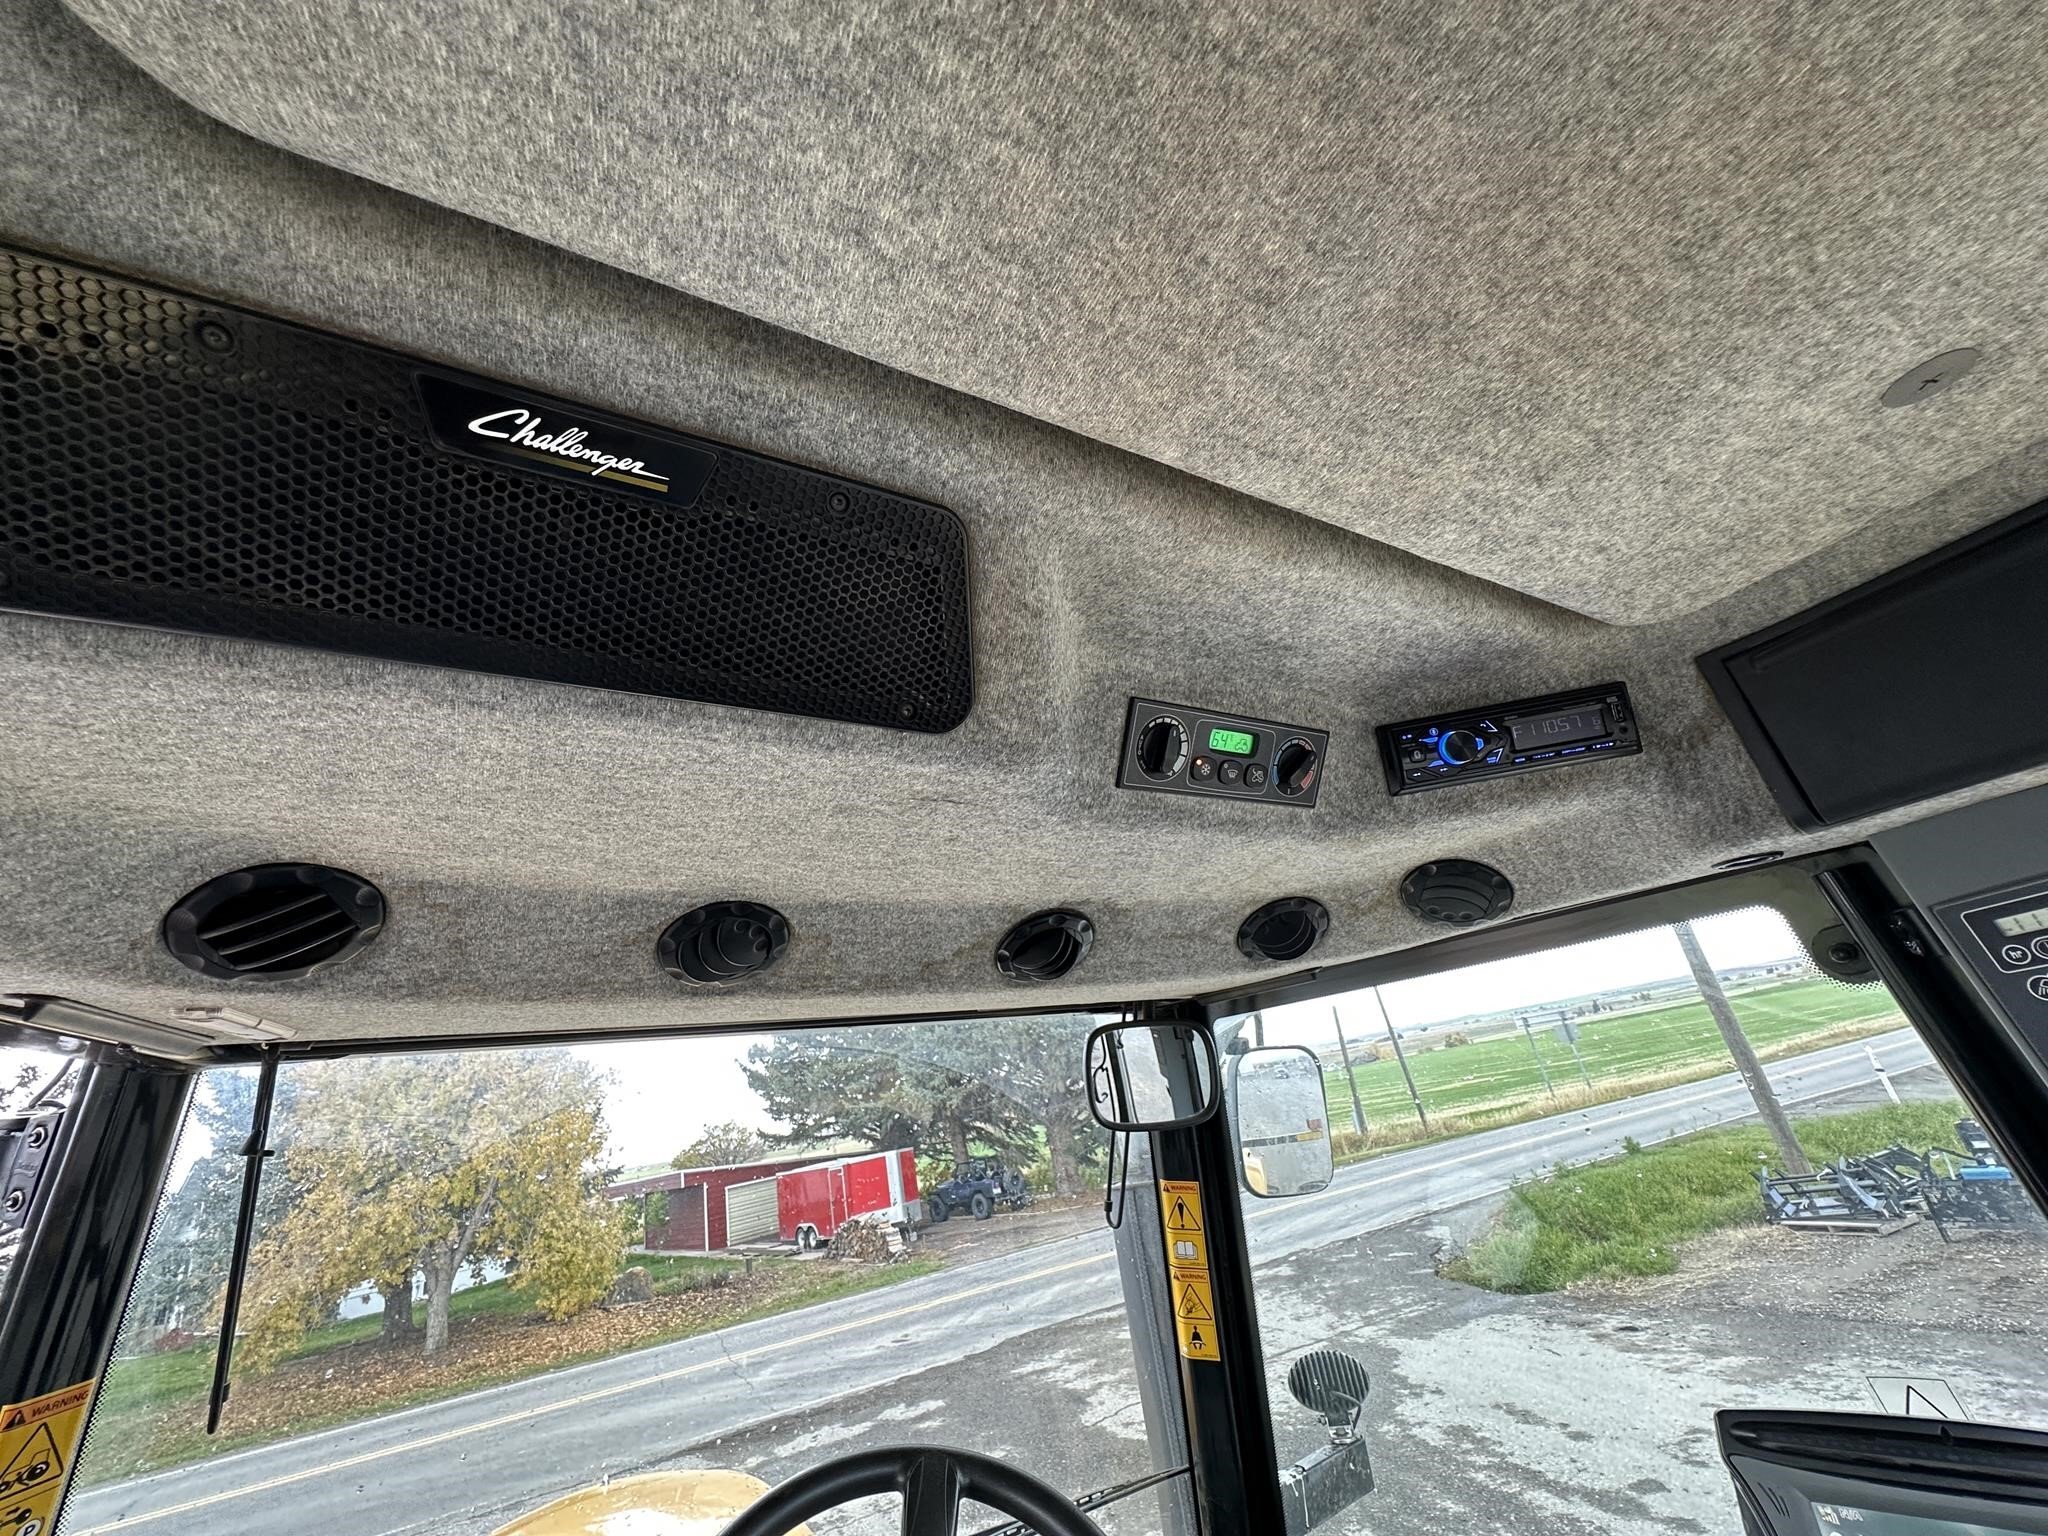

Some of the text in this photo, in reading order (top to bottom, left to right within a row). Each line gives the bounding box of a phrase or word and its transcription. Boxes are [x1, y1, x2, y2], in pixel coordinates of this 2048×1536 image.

[467, 409, 670, 476] Challenger
[1170, 1184, 1197, 1192] WARNING
[1180, 1272, 1207, 1280] WARNING
[31, 1390, 89, 1417] WARNING
